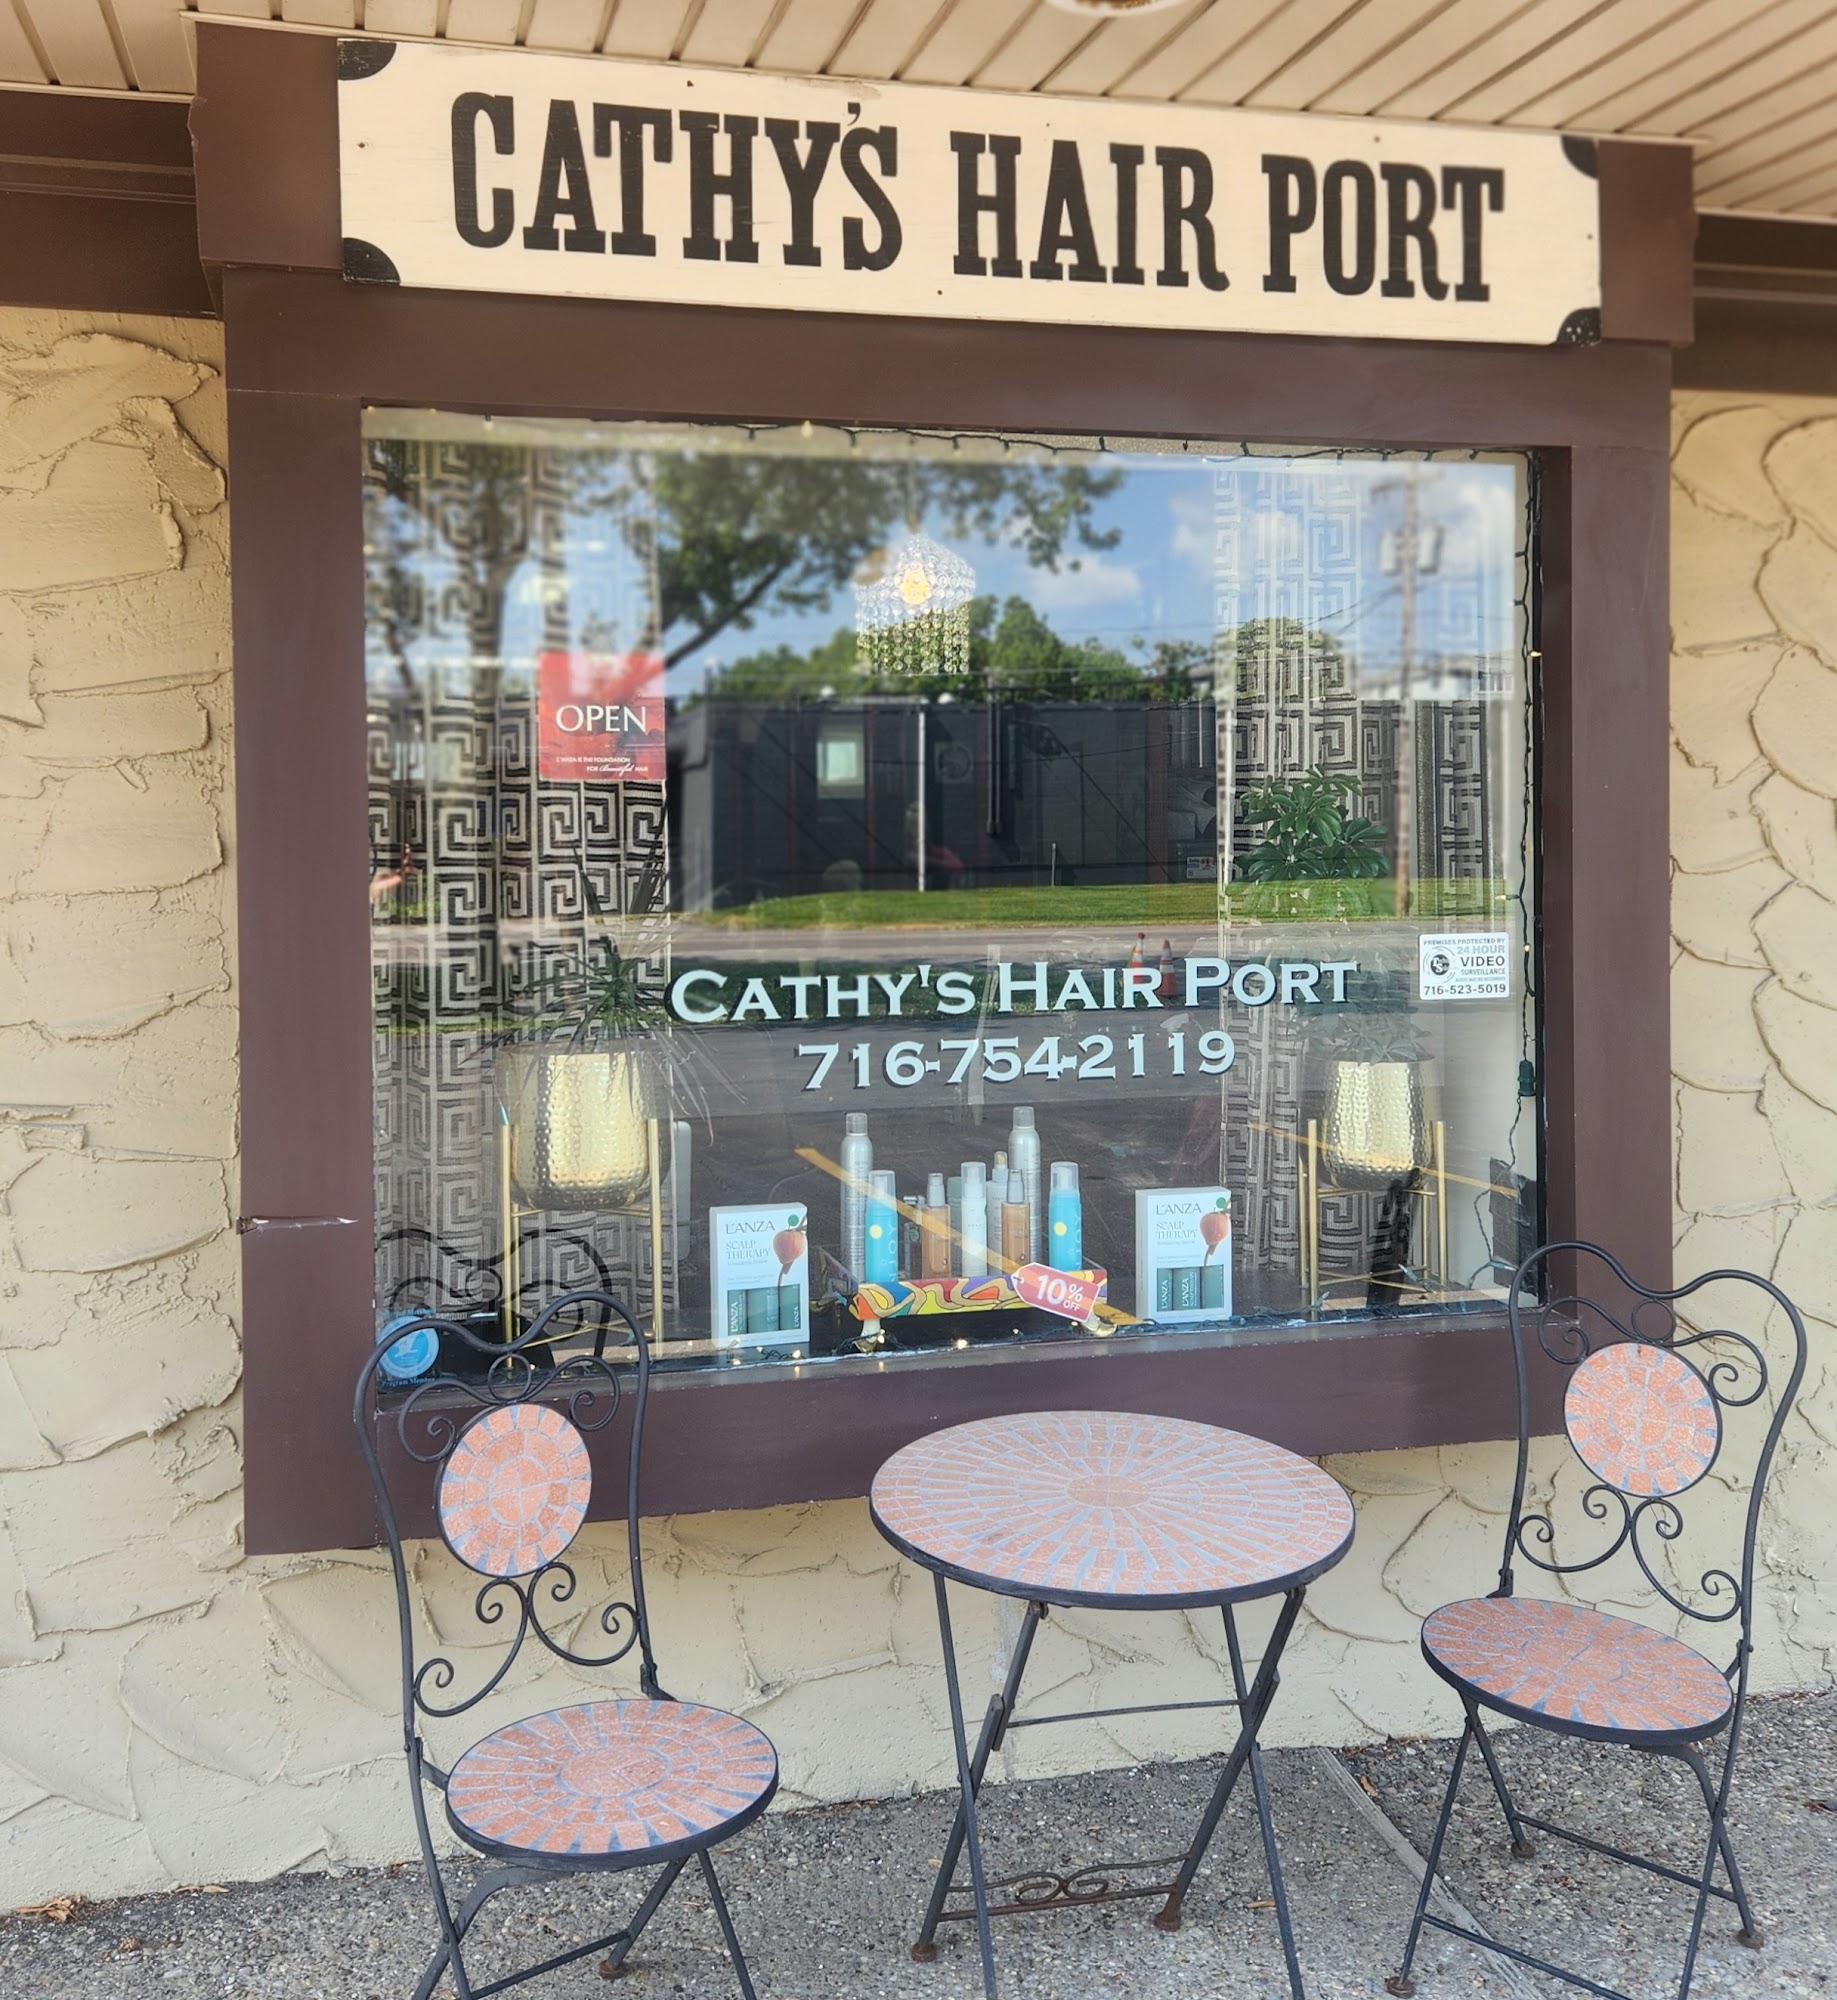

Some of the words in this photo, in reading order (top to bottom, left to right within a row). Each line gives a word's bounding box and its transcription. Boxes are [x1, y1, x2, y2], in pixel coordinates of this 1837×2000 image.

[451, 91, 903, 271] CATHY'S
[949, 130, 1230, 292] HAIR
[1261, 153, 1505, 302] PORT
[555, 704, 647, 736] OPEN
[1473, 945, 1505, 954] HOUR
[1460, 955, 1505, 967] VIDEO
[671, 964, 976, 1023] CATHY'S
[998, 961, 1165, 1013] HAIR
[1184, 957, 1359, 1007] PORT
[1424, 983, 1506, 996] 716-523-5019
[797, 1030, 1236, 1090] 716-754-2119
[1156, 1202, 1202, 1215] L'ANZA
[726, 1220, 776, 1235] L'ANZA
[1156, 1220, 1184, 1231] SCALP
[1156, 1229, 1197, 1240] THERAPY
[726, 1239, 756, 1250] SCALP
[725, 1248, 769, 1259] THERAPY
[1037, 1274, 1083, 1305] 10%
[1063, 1299, 1081, 1312] OFF
